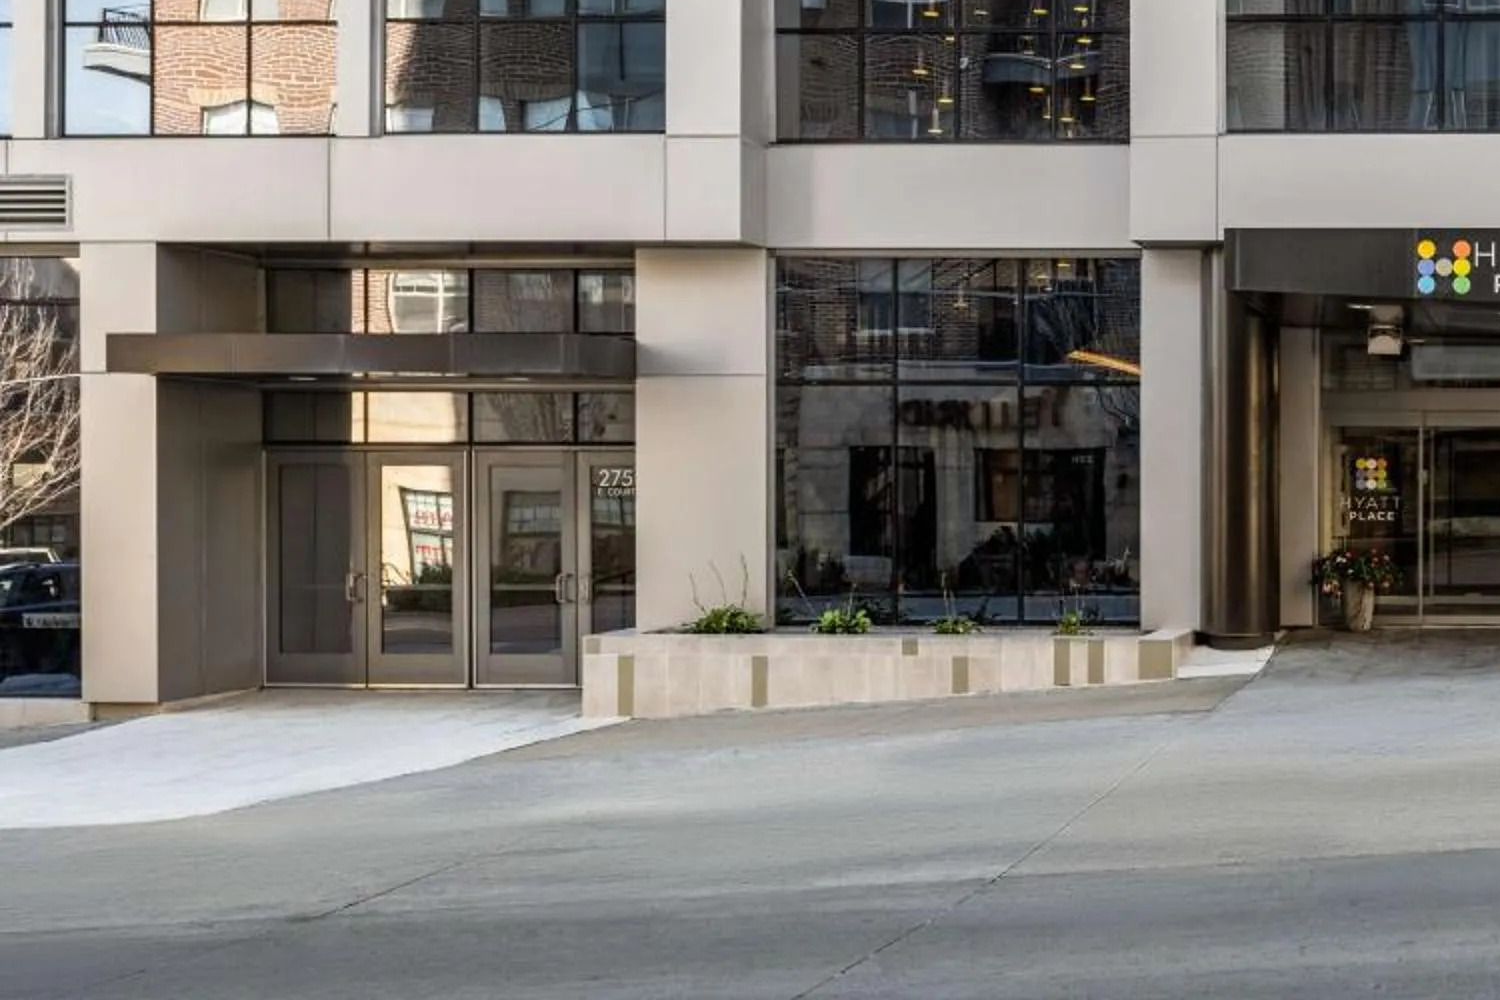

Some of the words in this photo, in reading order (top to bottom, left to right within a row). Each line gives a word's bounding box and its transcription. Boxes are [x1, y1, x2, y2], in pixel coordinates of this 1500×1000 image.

[599, 469, 633, 487] 275
[1340, 496, 1400, 509] HYATT
[1349, 511, 1396, 521] PLACE
